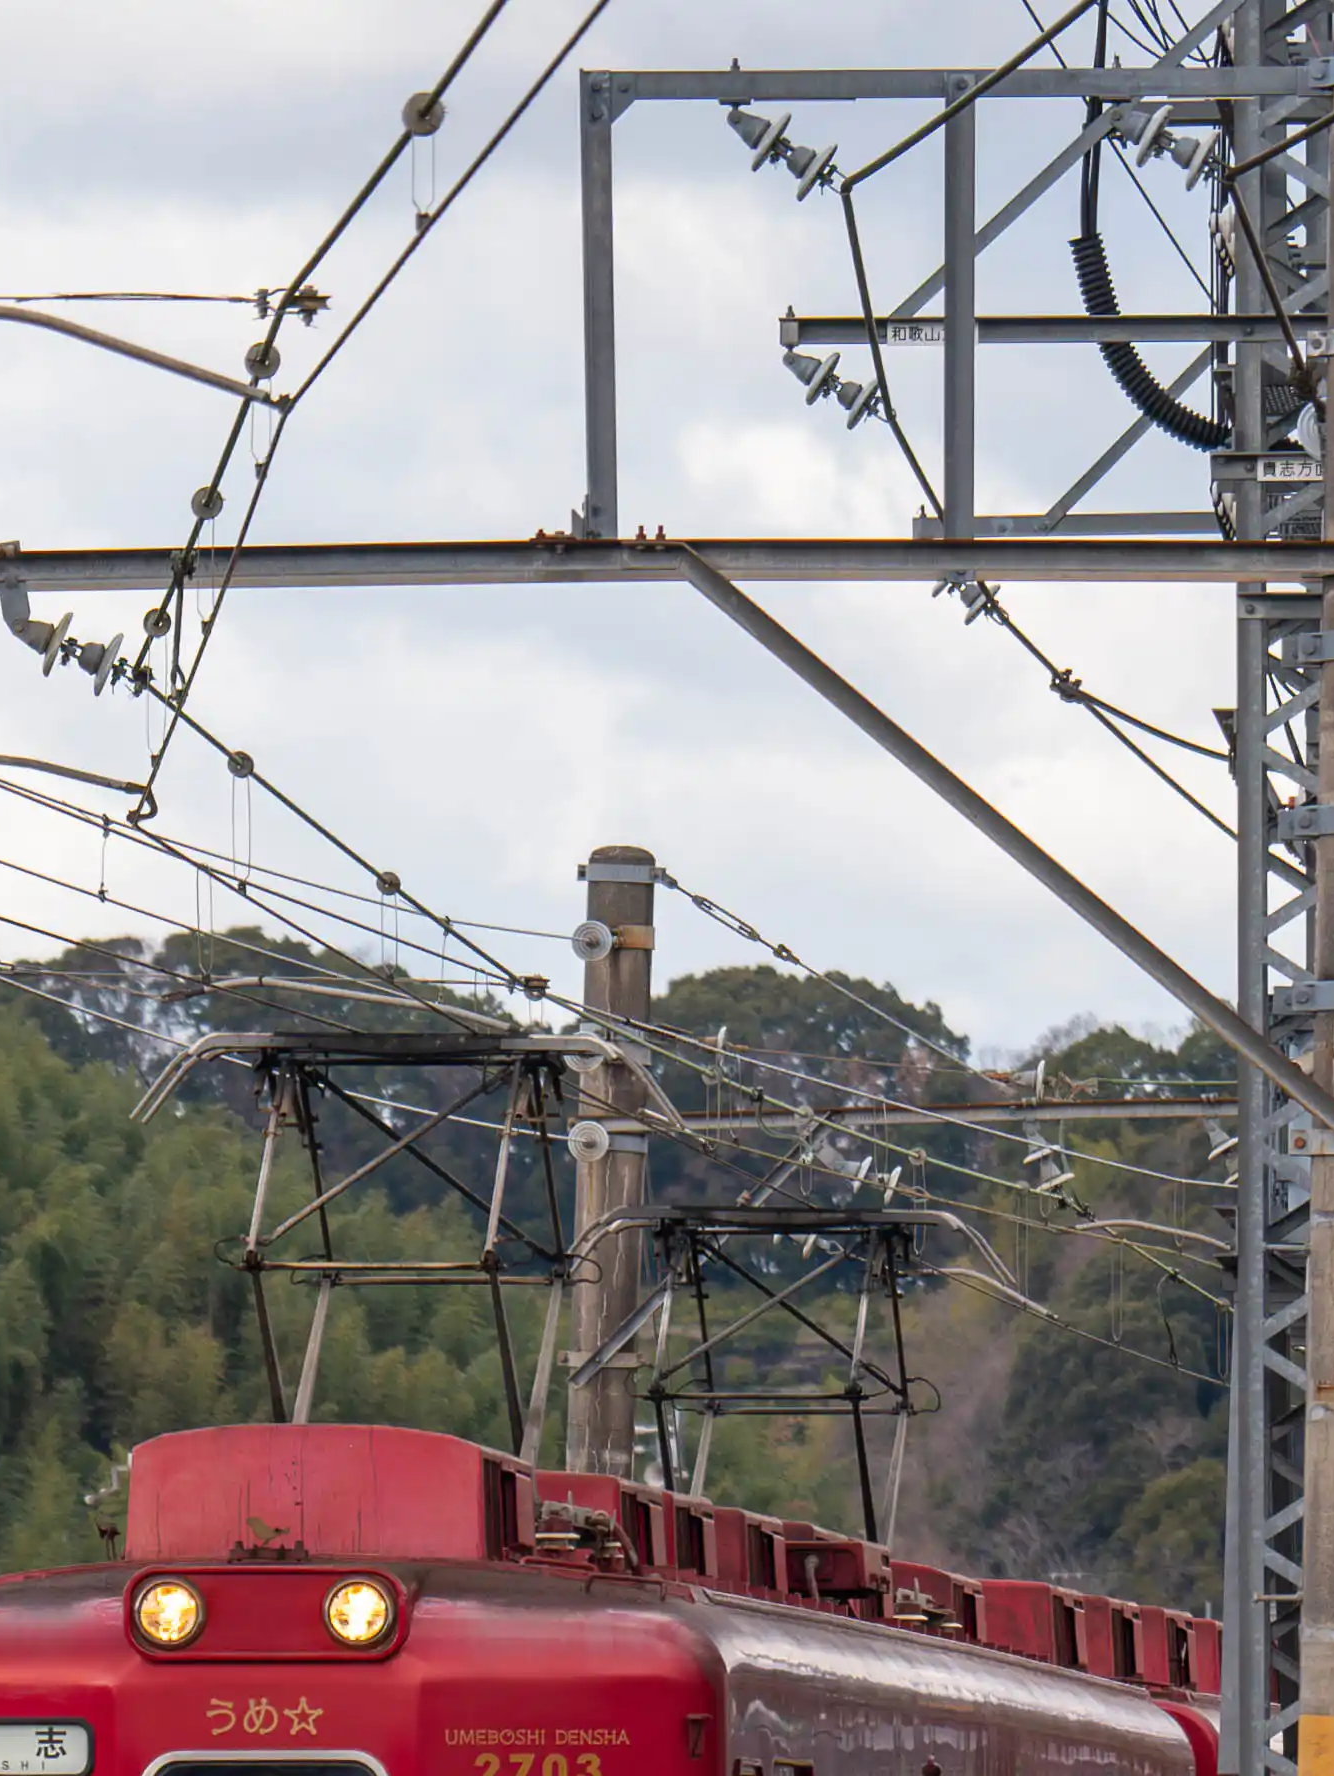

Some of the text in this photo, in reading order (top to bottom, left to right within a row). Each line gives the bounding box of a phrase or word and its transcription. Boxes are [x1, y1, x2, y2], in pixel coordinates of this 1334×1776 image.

[891, 325, 945, 342] 和歌山
[445, 1728, 631, 1746] UMEBOSHI DENSHA
